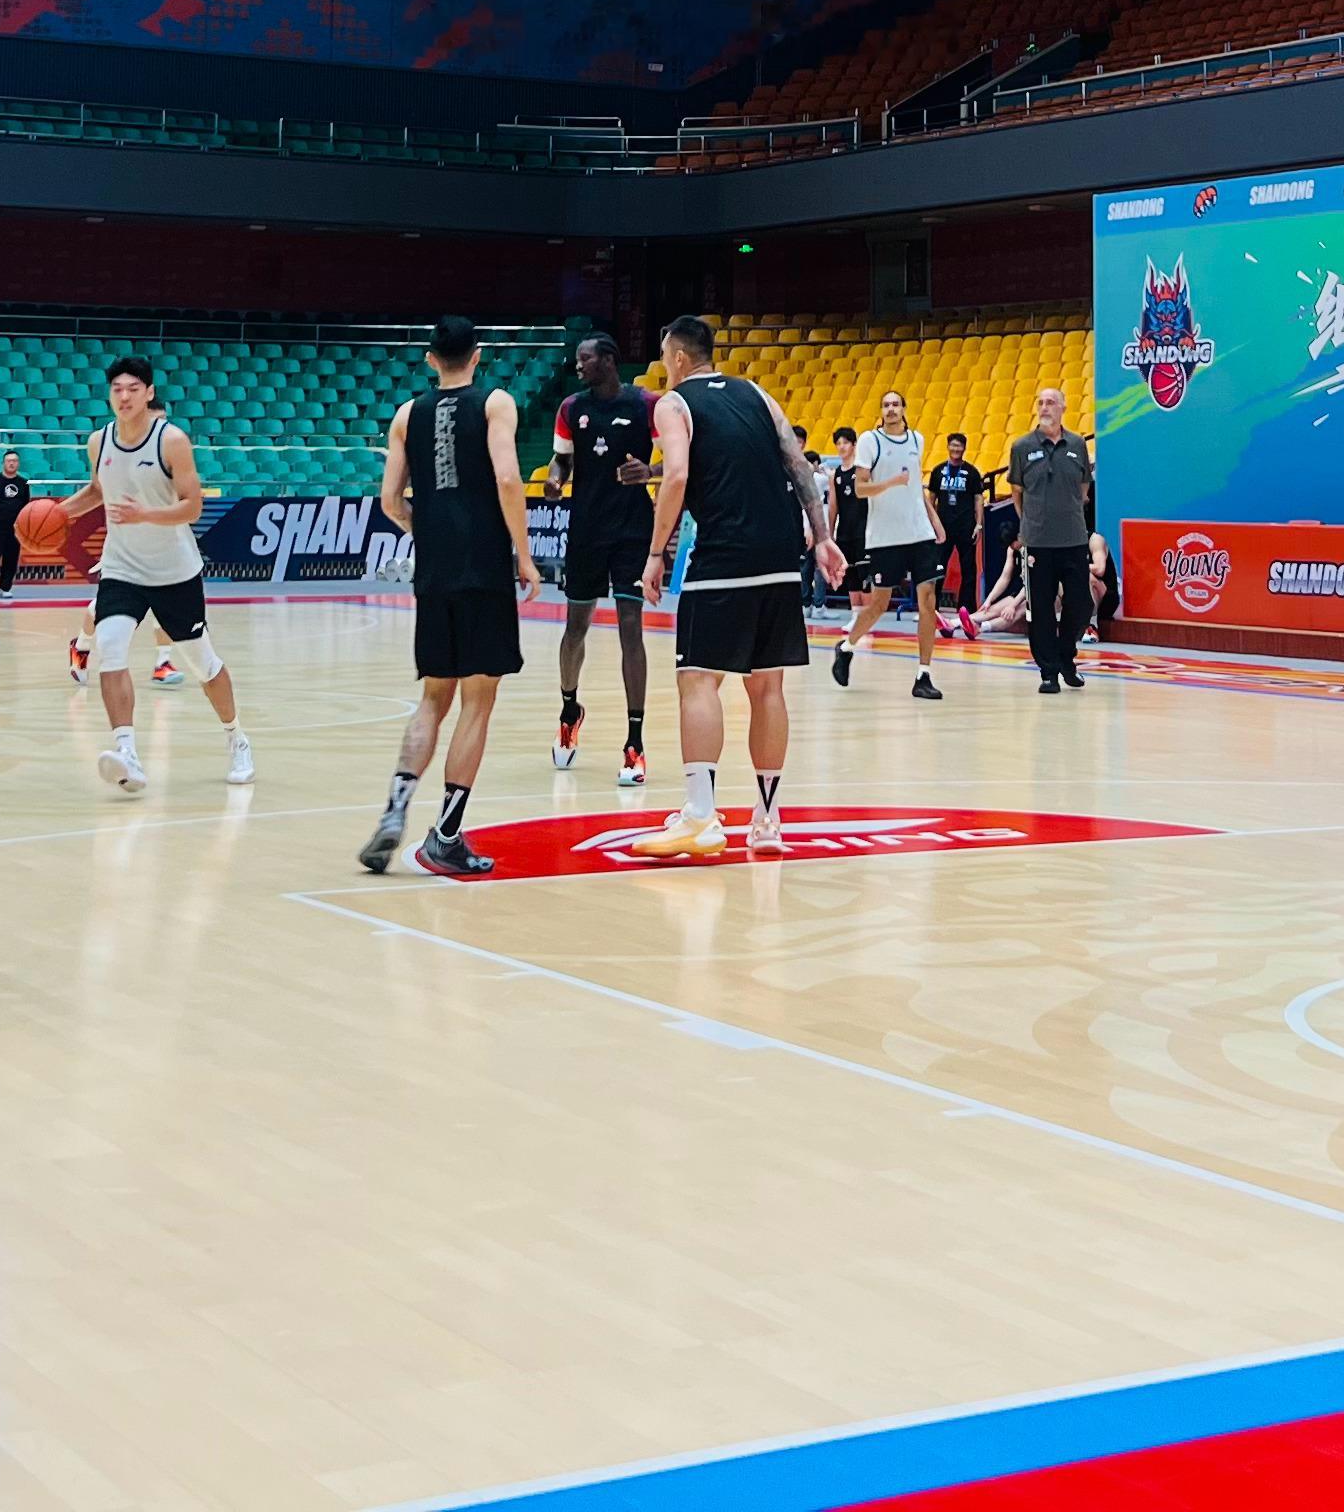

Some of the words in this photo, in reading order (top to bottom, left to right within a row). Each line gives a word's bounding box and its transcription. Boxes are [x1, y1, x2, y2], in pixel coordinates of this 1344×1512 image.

[1107, 197, 1164, 220] SHANDONG
[1250, 179, 1314, 206] SHANDONG
[1125, 343, 1211, 364] SHANDONG
[1162, 549, 1231, 589] YOUNG
